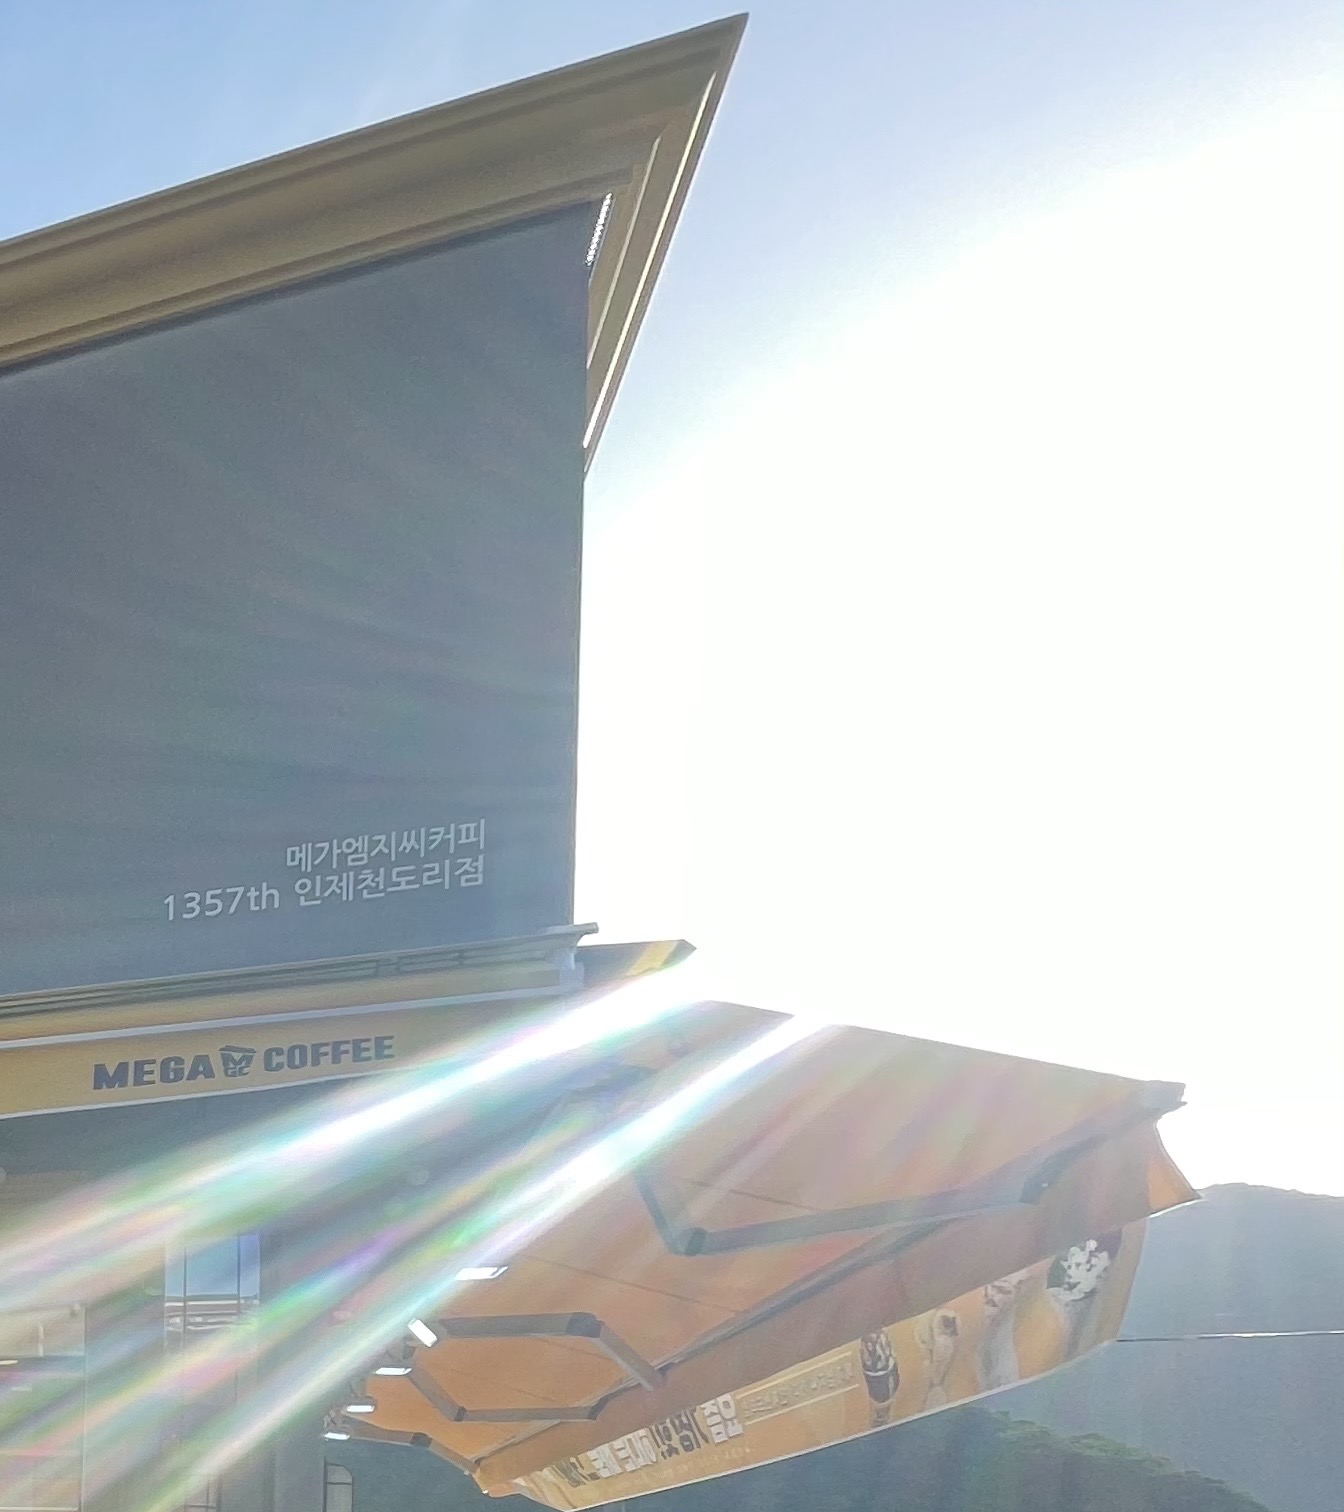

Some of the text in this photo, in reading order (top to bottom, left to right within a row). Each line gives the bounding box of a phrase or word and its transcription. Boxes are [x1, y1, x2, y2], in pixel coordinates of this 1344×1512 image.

[285, 819, 486, 873] 메가엠지씨커피
[163, 856, 484, 921] 1357th 인제천도리점
[92, 1035, 395, 1091] MEGA COFFEE
